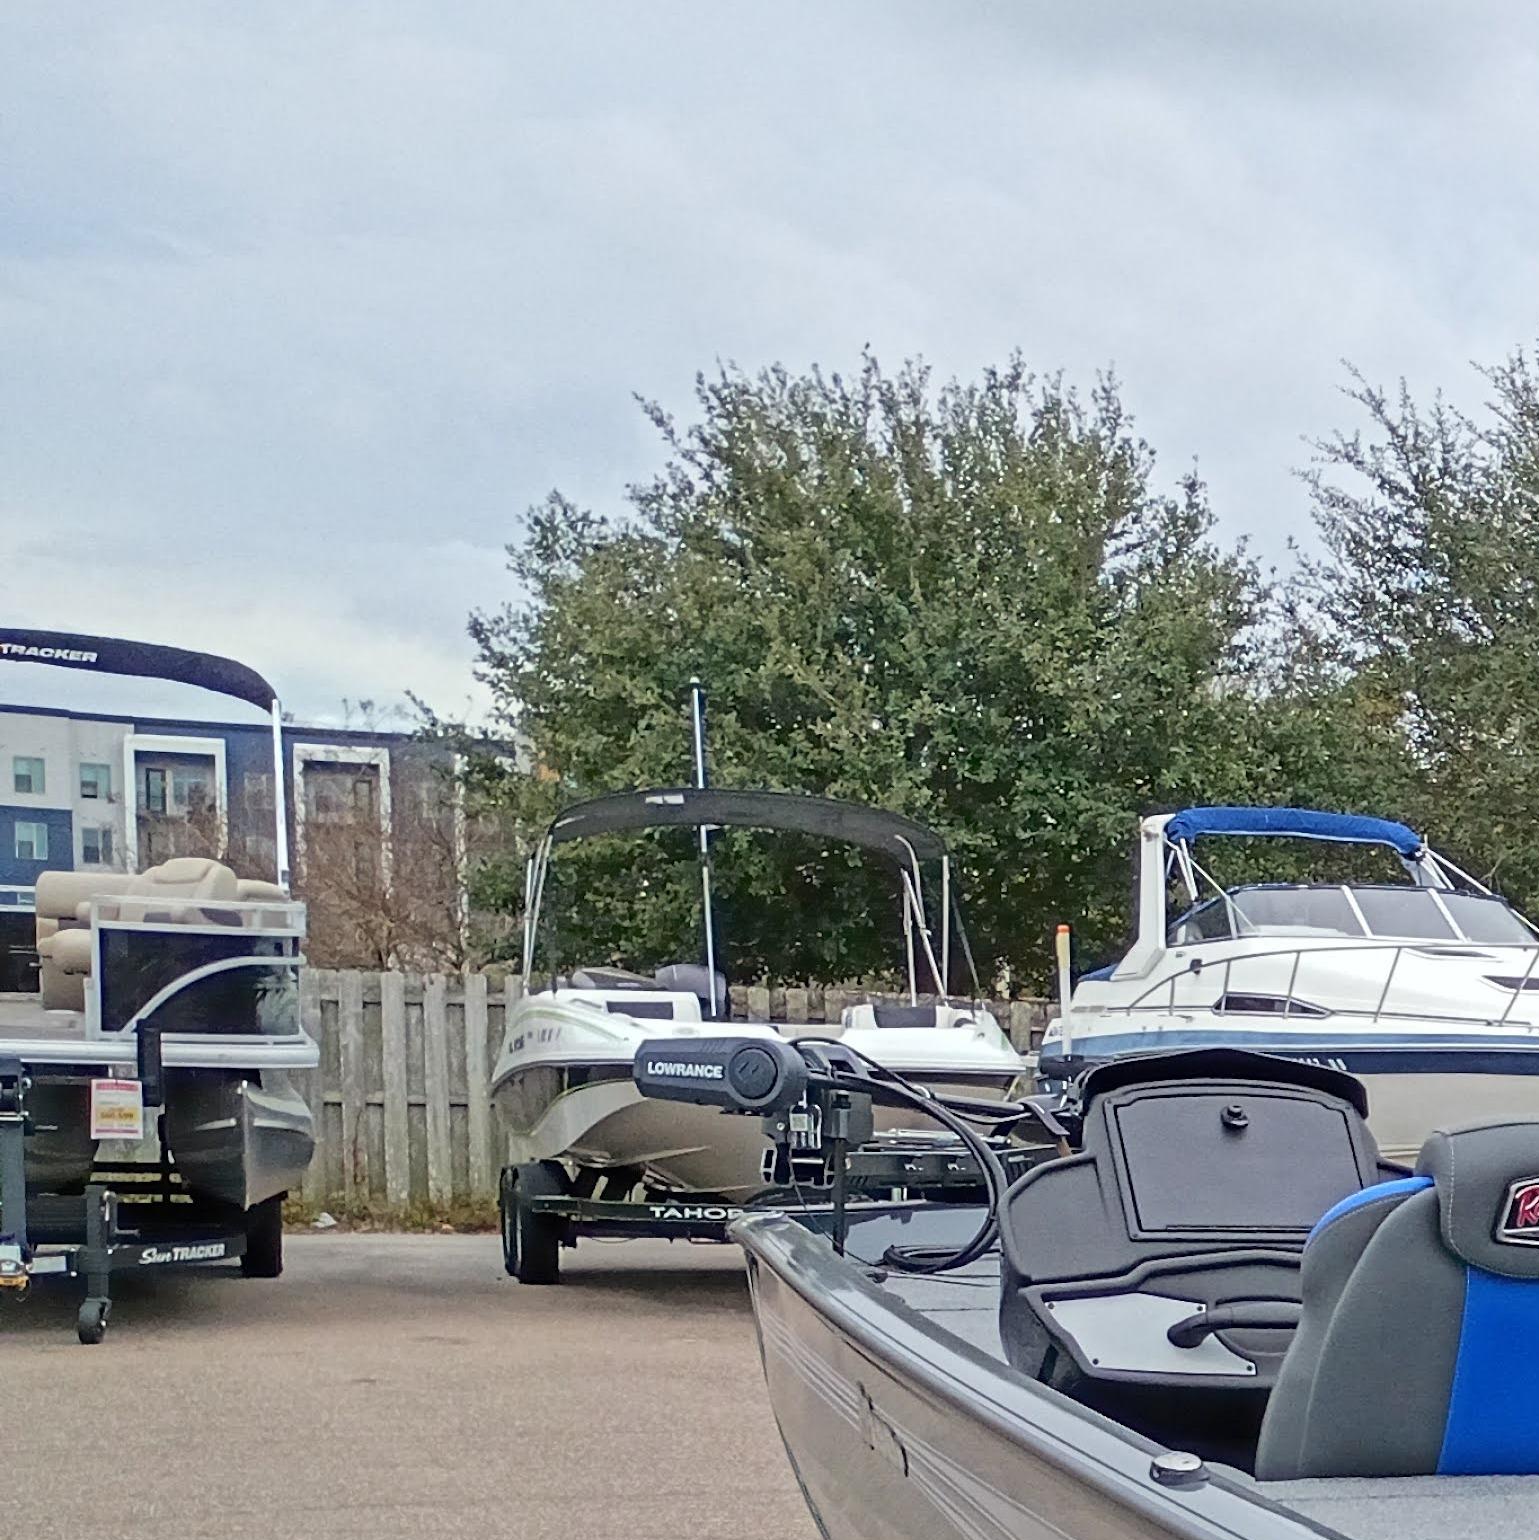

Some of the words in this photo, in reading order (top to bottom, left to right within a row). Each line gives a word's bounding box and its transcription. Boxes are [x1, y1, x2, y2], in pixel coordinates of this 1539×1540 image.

[0, 643, 98, 662] TRACKER
[647, 1061, 724, 1079] LOWRANCE
[172, 1243, 226, 1262] TRACKER
